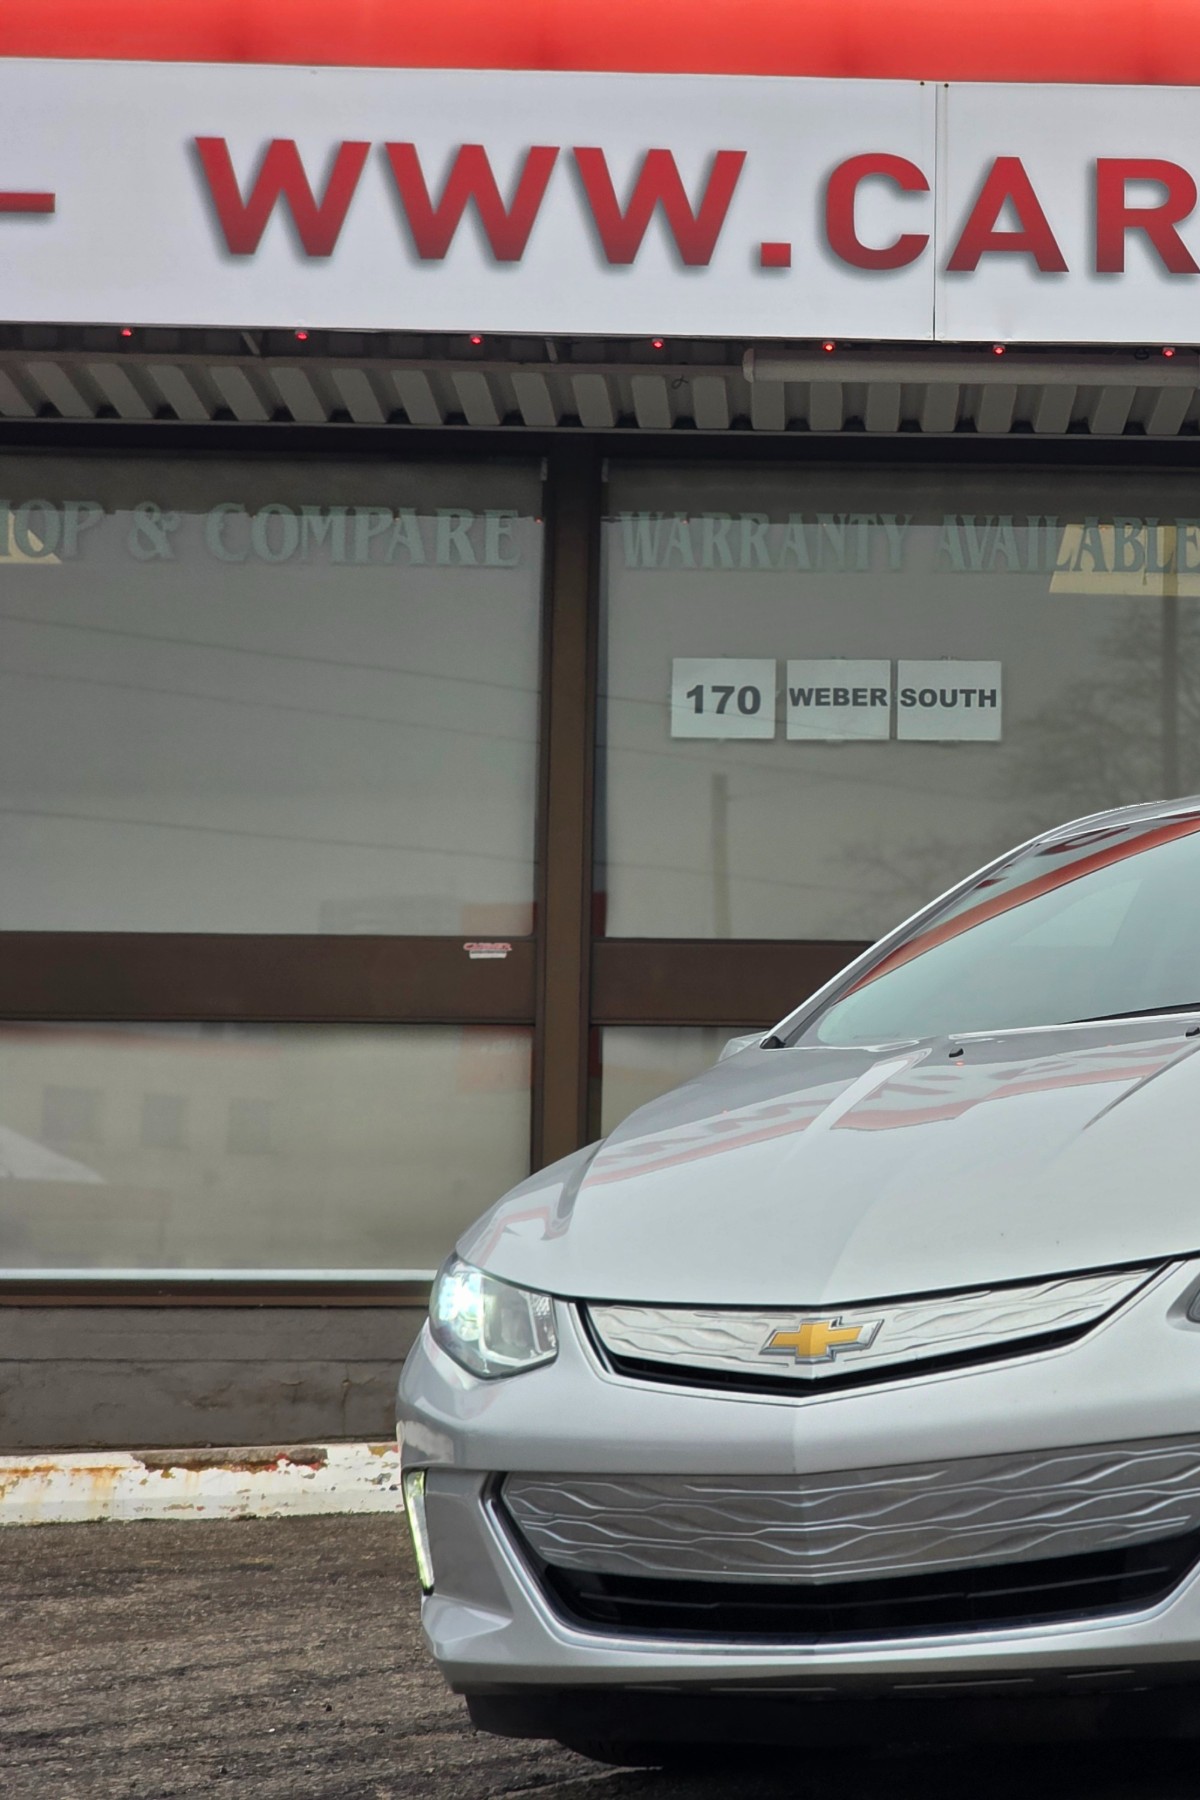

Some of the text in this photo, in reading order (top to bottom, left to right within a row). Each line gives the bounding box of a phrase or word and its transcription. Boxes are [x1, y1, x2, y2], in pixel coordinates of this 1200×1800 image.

[0, 499, 522, 567] OP & COMPARE
[617, 510, 913, 571] WARRANTY
[686, 684, 997, 715] 170 WEBER SOUTH
